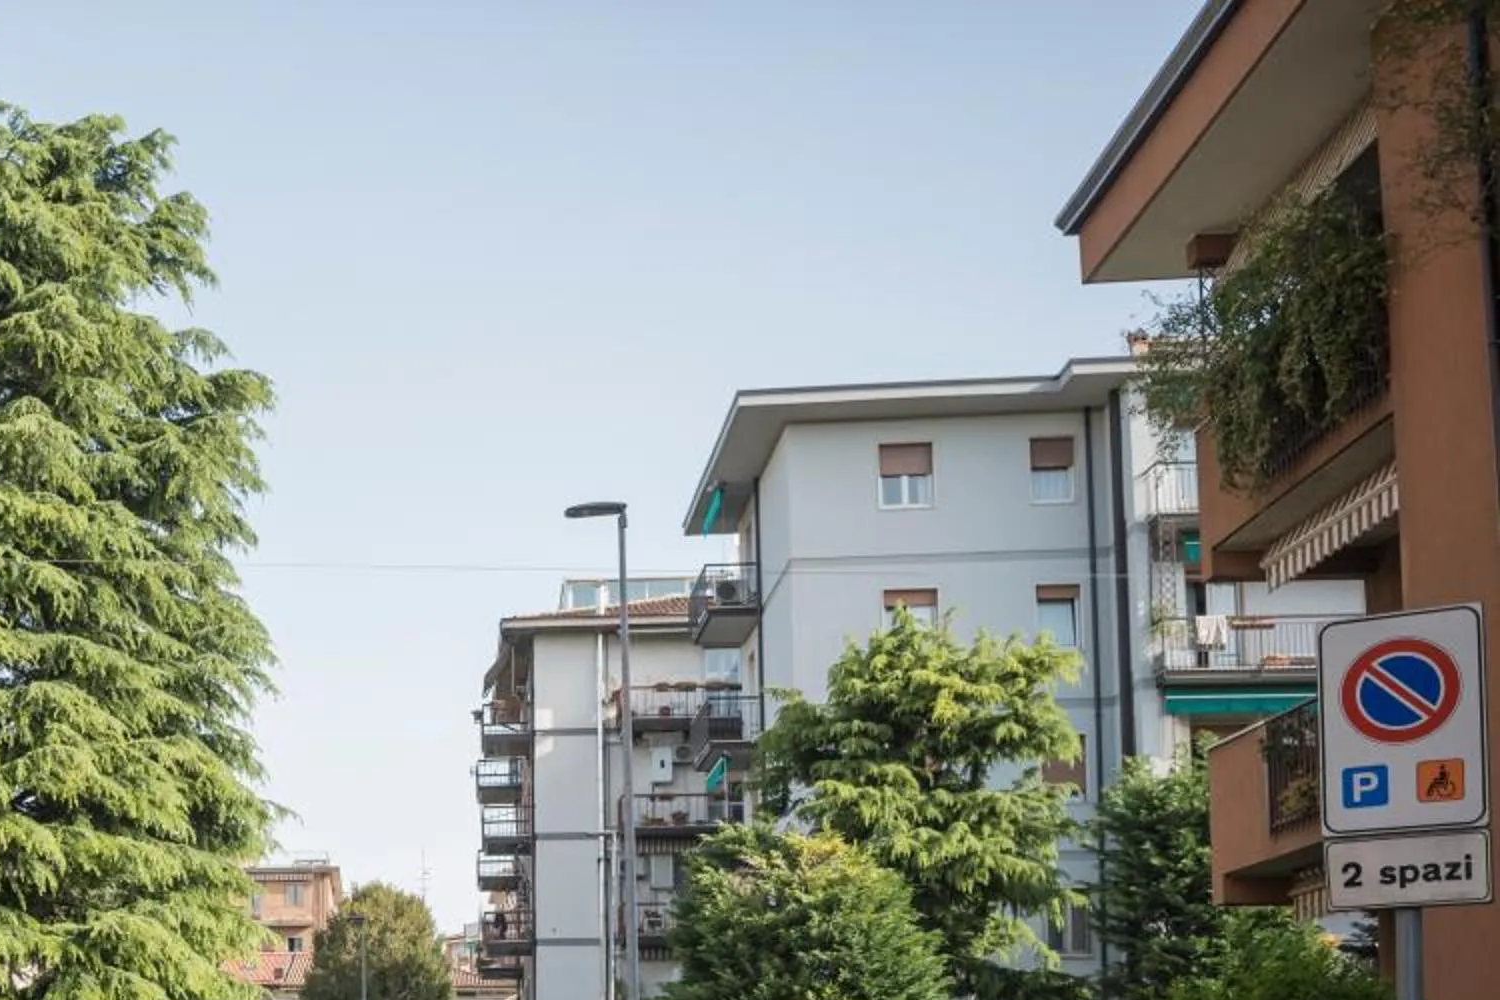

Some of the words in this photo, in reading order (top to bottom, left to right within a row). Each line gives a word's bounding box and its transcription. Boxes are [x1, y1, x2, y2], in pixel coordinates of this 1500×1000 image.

[1352, 770, 1379, 803] P
[1341, 861, 1363, 888] 2
[1379, 853, 1473, 889] spazi
